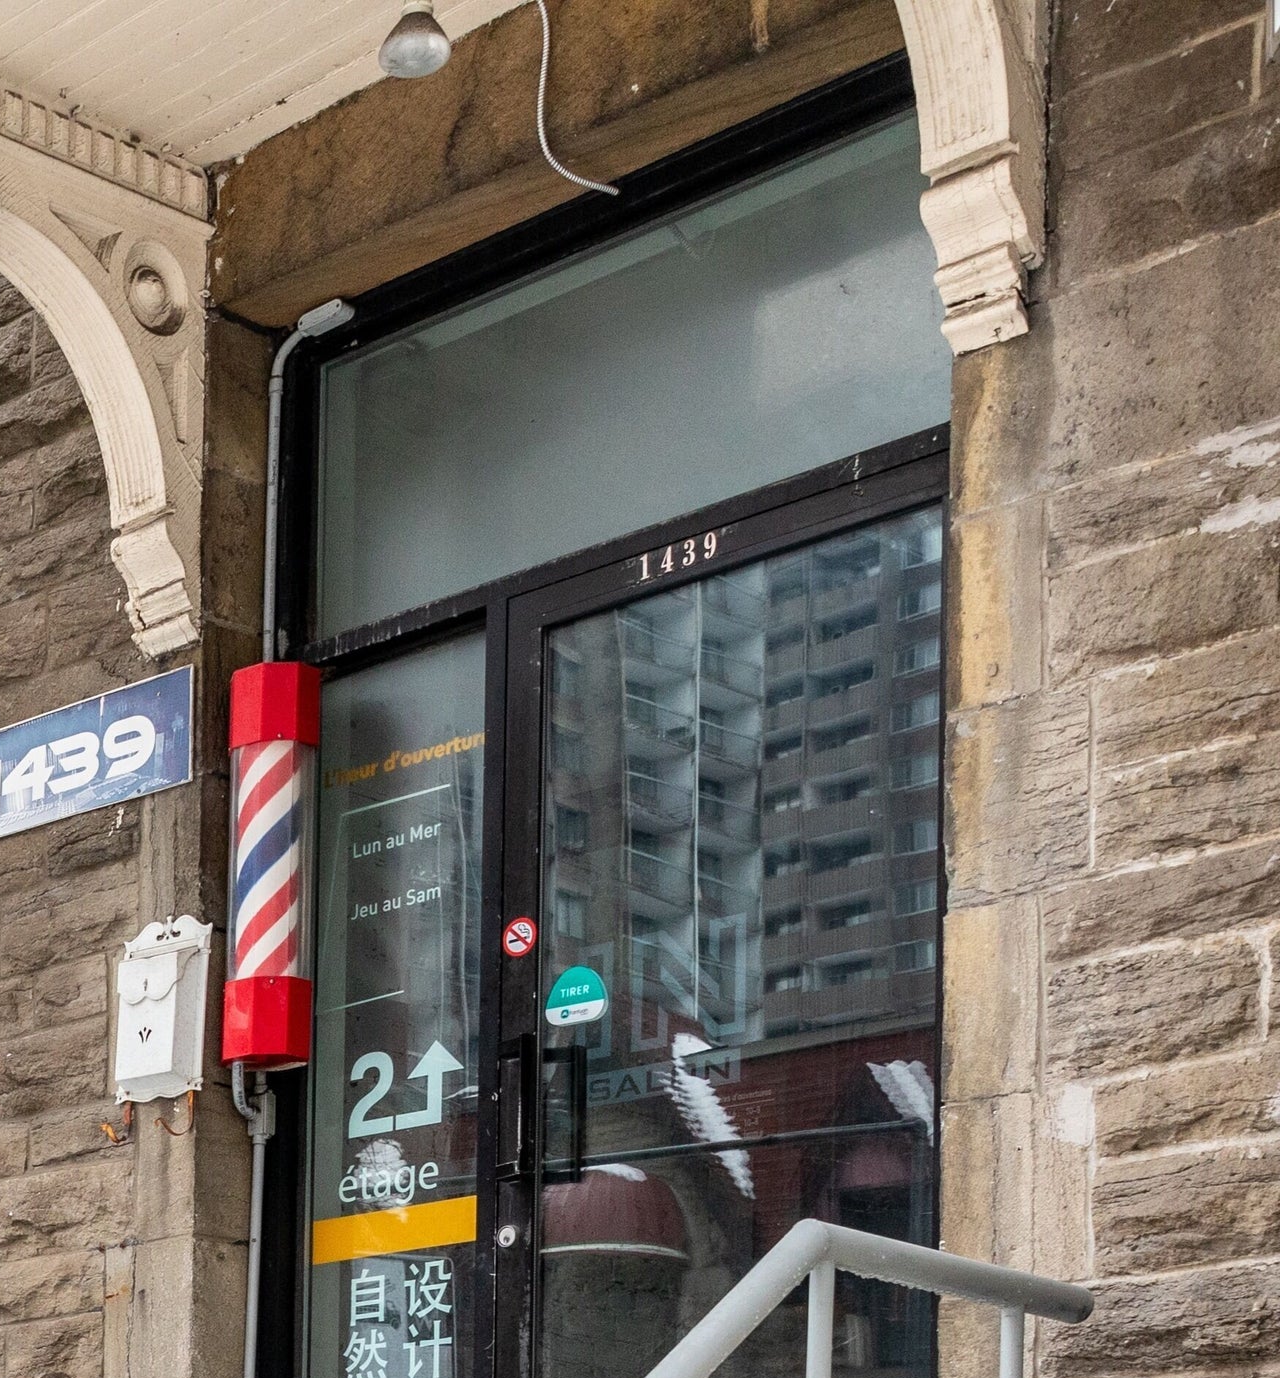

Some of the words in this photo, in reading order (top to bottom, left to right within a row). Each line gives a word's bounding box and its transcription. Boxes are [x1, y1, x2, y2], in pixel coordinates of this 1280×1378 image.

[639, 532, 719, 580] 1439
[352, 840, 382, 859] Lun
[386, 833, 405, 850] au
[409, 821, 442, 843] Mer
[350, 902, 378, 921] Jeu
[382, 895, 401, 912] au
[406, 885, 441, 906] Sam
[560, 984, 590, 998] TIRER
[348, 1051, 395, 1139] 2
[338, 1158, 441, 1205] étage
